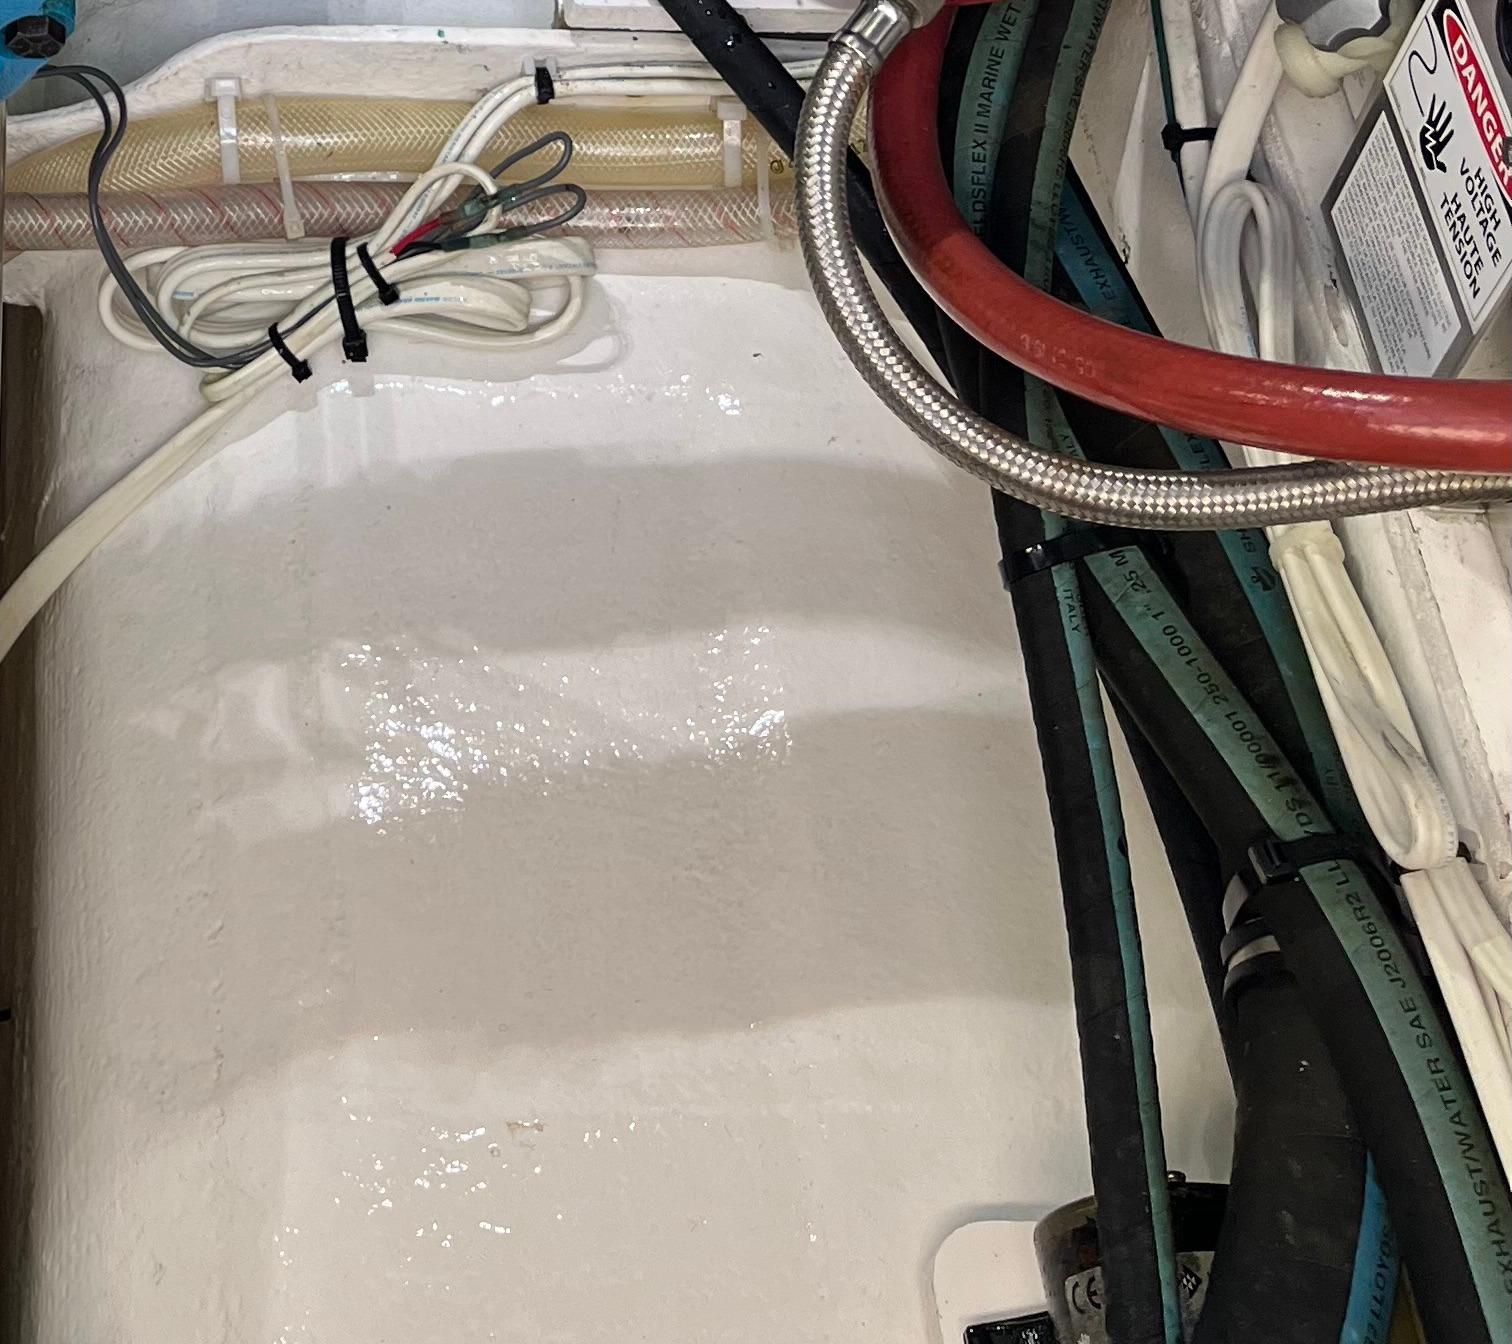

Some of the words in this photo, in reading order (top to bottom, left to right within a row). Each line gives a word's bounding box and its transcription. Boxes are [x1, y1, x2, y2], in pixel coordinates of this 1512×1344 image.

[976, 39, 1006, 121] MARINE
[997, 2, 1023, 43] WET
[1450, 191, 1484, 278] HAUTE
[1458, 156, 1502, 267] VOLTAGE
[1473, 167, 1502, 232] HIGH
[1439, 193, 1481, 300] TENSION
[1063, 587, 1082, 634] ITALY
[1162, 623, 1225, 708] 250-1000
[1345, 892, 1409, 988] J2006R2
[1398, 993, 1434, 1049] SAE
